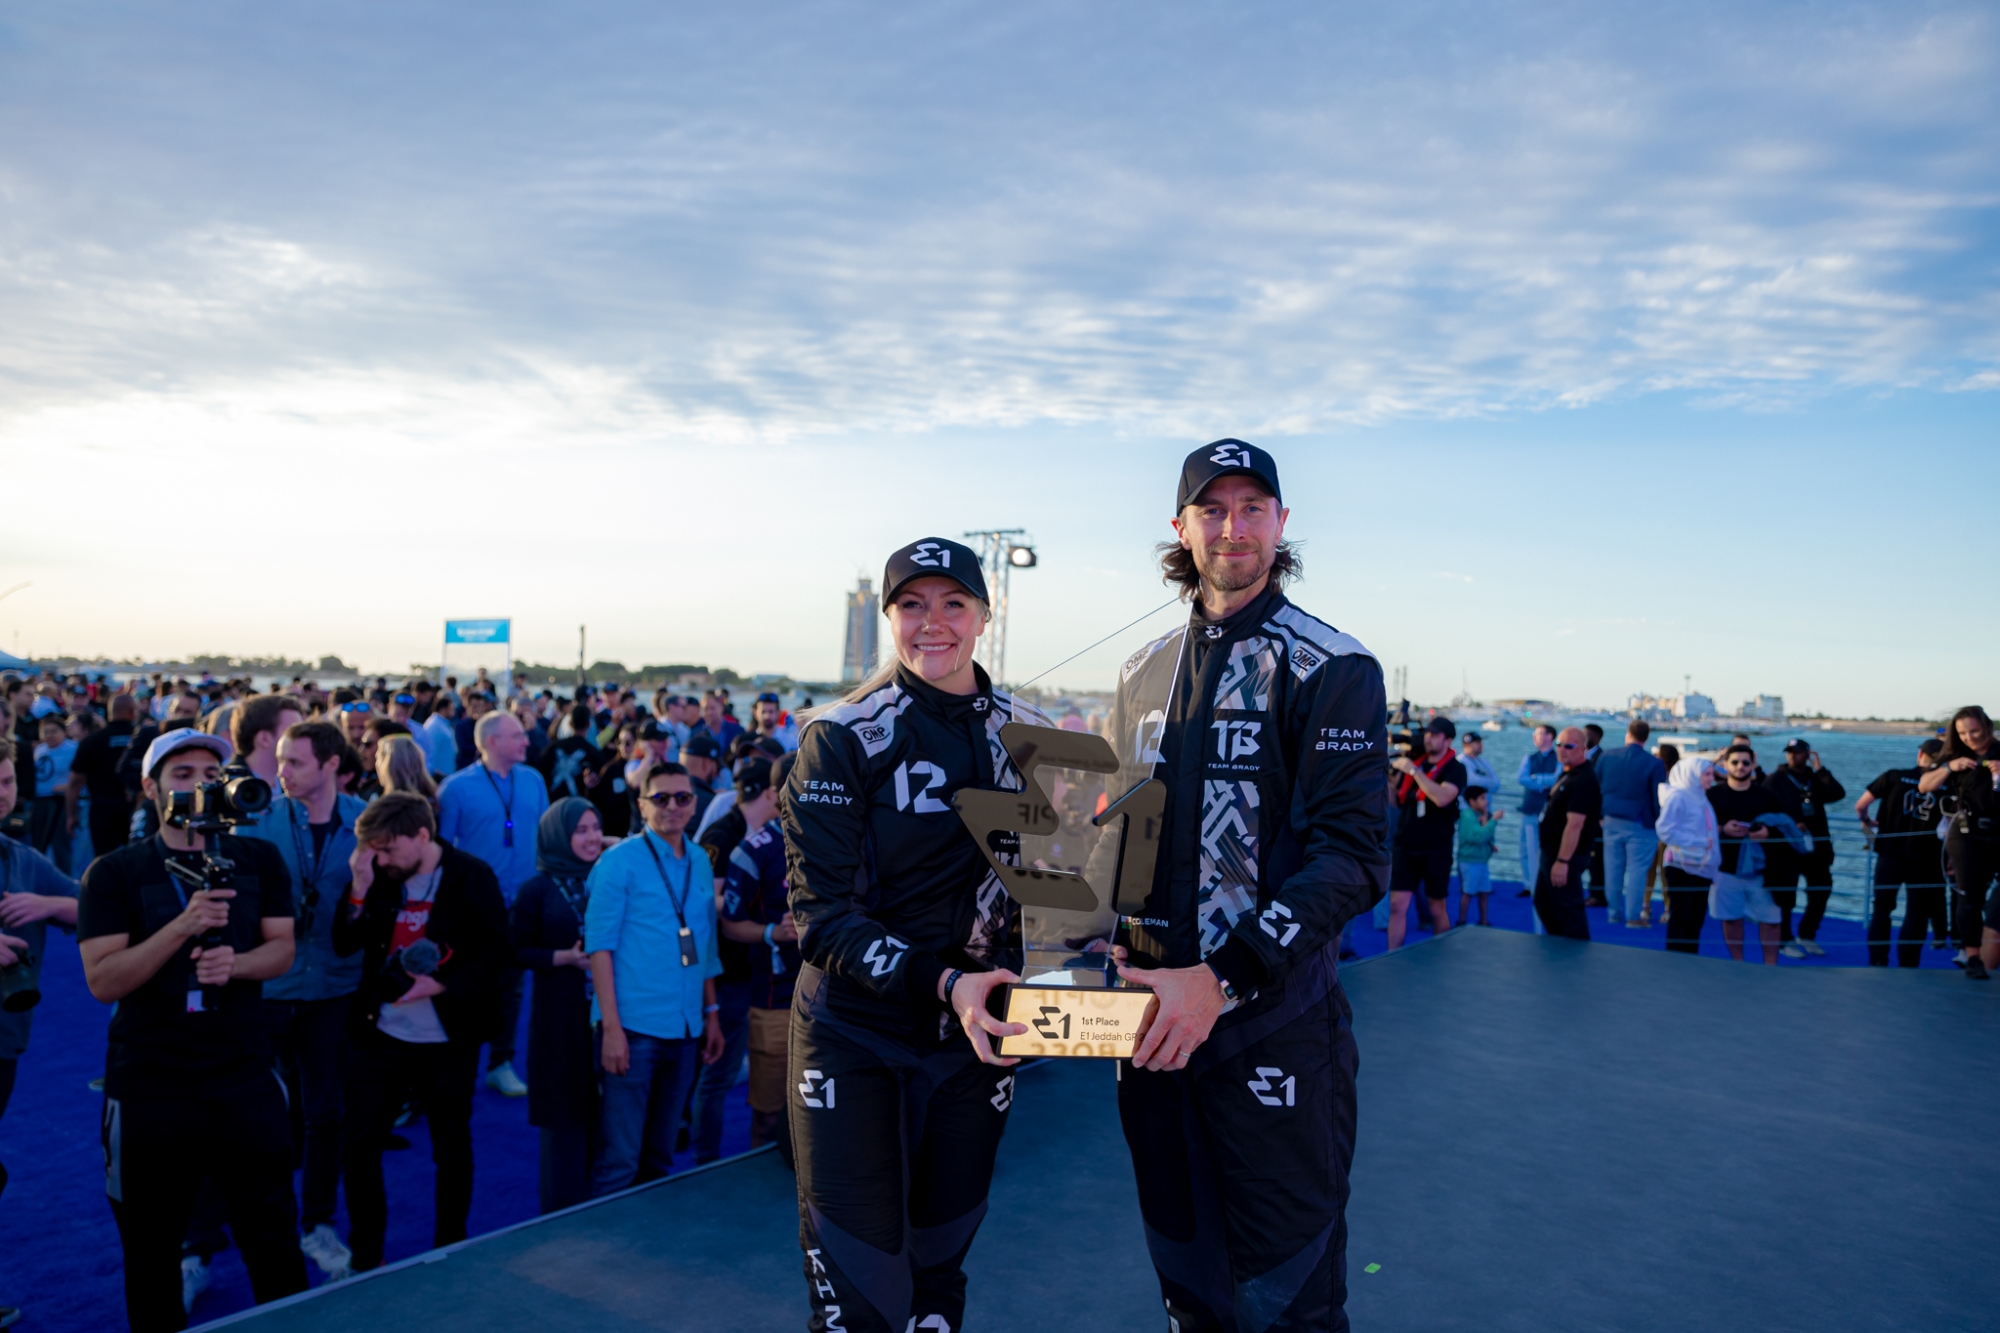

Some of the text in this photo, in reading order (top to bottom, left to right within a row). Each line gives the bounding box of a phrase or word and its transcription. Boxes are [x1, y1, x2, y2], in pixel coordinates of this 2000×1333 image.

[1291, 649, 1318, 669] OMP
[862, 726, 886, 741] OMP
[1319, 727, 1365, 739] TEAM
[1315, 740, 1374, 751] BRADY
[1231, 764, 1260, 772] BRADY
[802, 780, 845, 792] TEAM
[894, 760, 951, 814] 12
[798, 792, 853, 806] BRADY
[1131, 917, 1169, 928] COLEMAN
[1081, 1016, 1120, 1027] 1st Place
[1080, 1031, 1089, 1041] E1
[1091, 1032, 1122, 1041] Jeddah
[1124, 1032, 1137, 1042] GP
